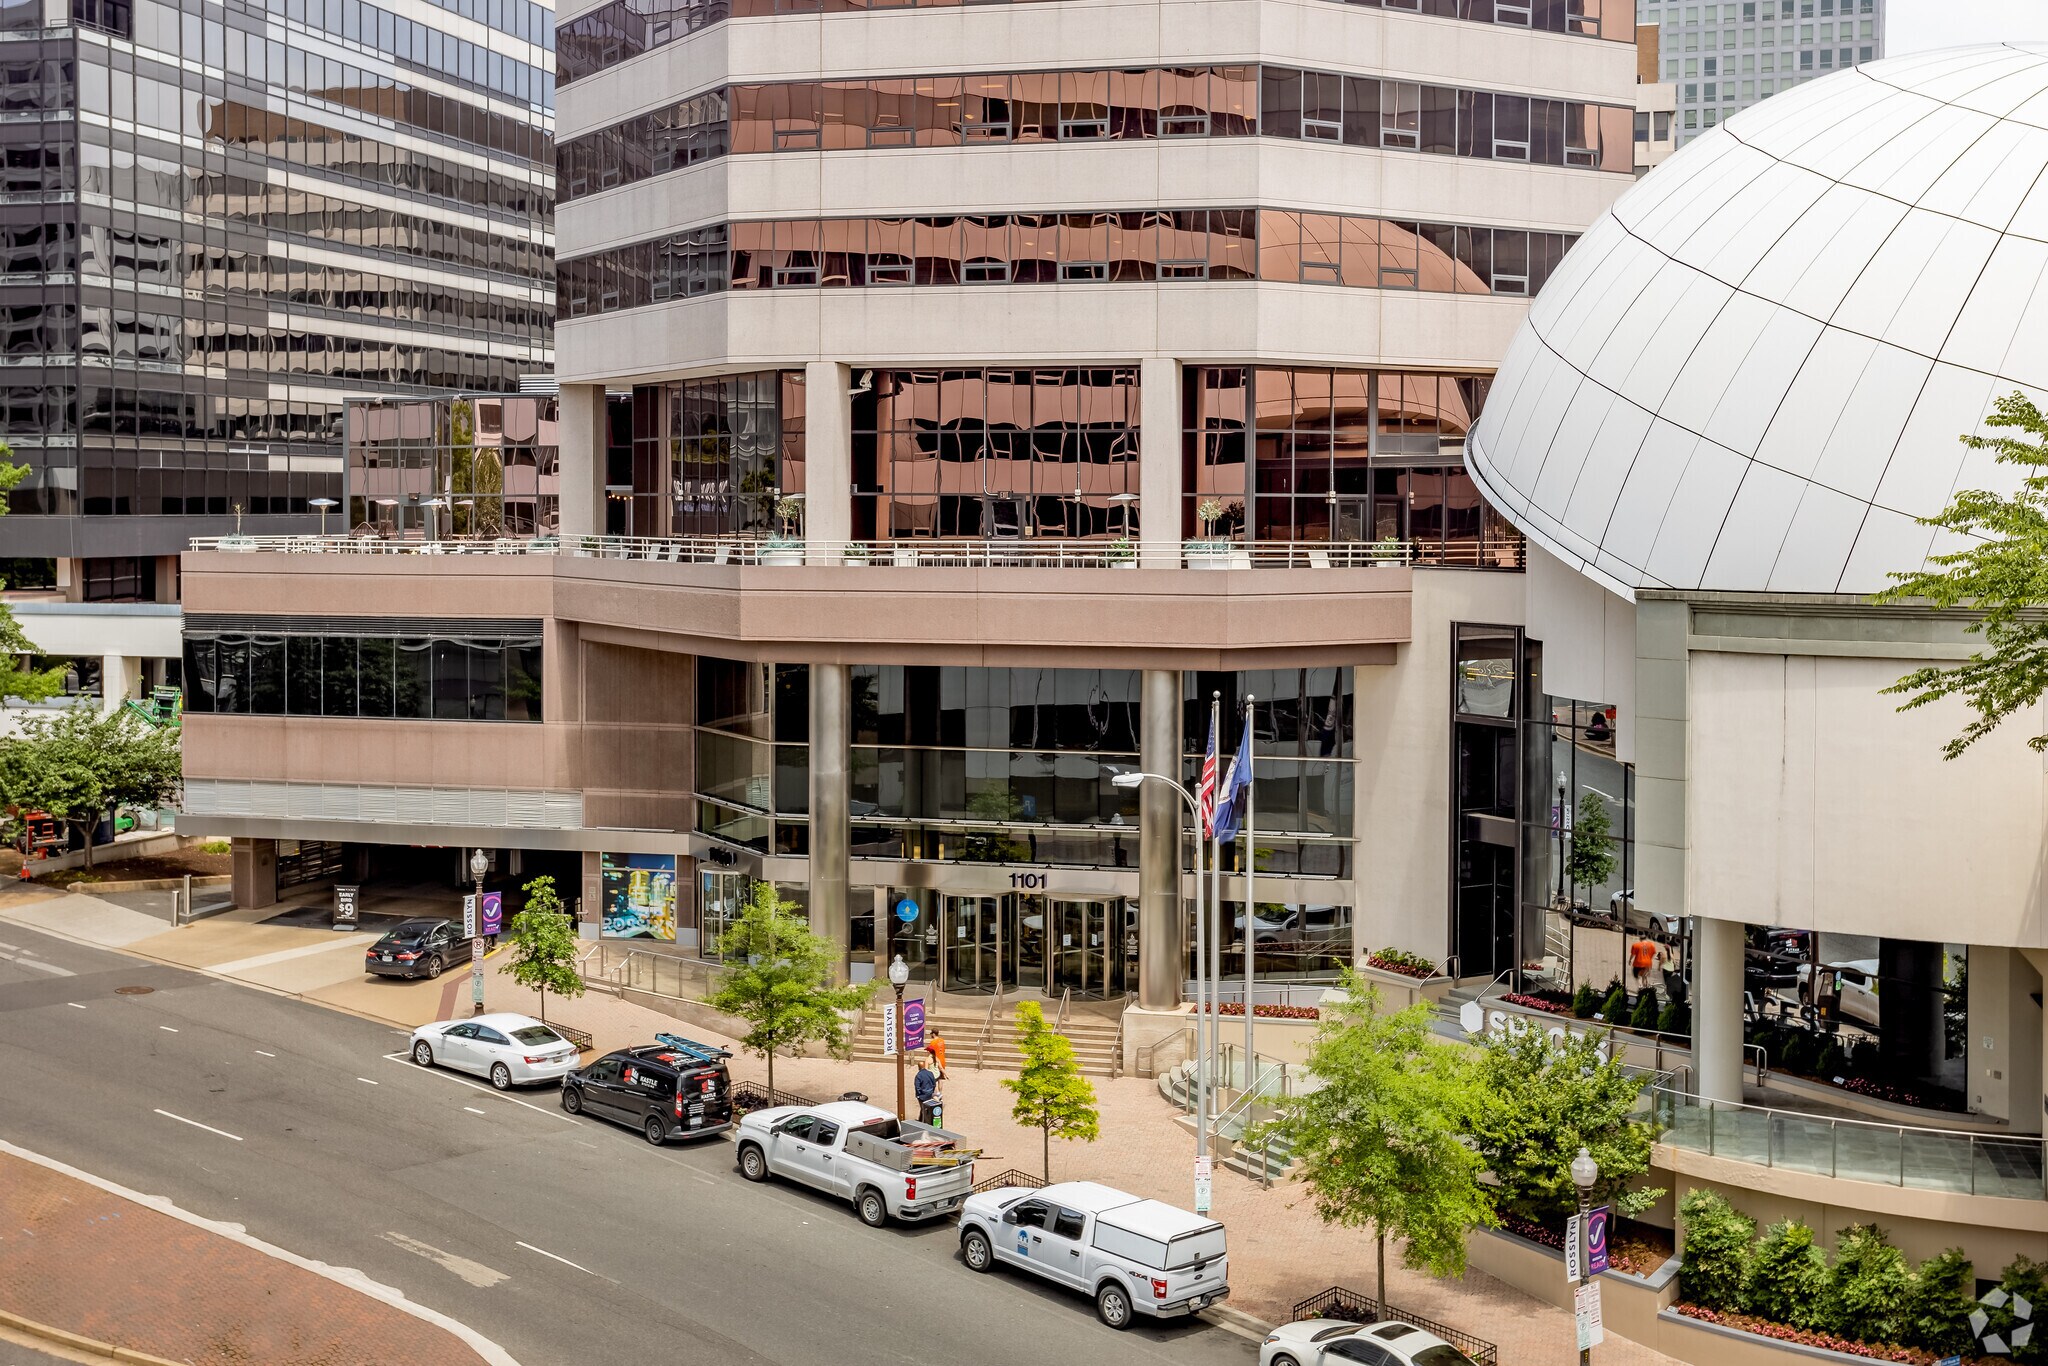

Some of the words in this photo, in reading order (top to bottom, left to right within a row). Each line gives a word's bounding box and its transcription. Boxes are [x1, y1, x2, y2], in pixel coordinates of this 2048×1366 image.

[1009, 873, 1046, 889] 1101
[339, 903, 354, 916] $9
[1569, 1220, 1577, 1277] ROSSLYN
